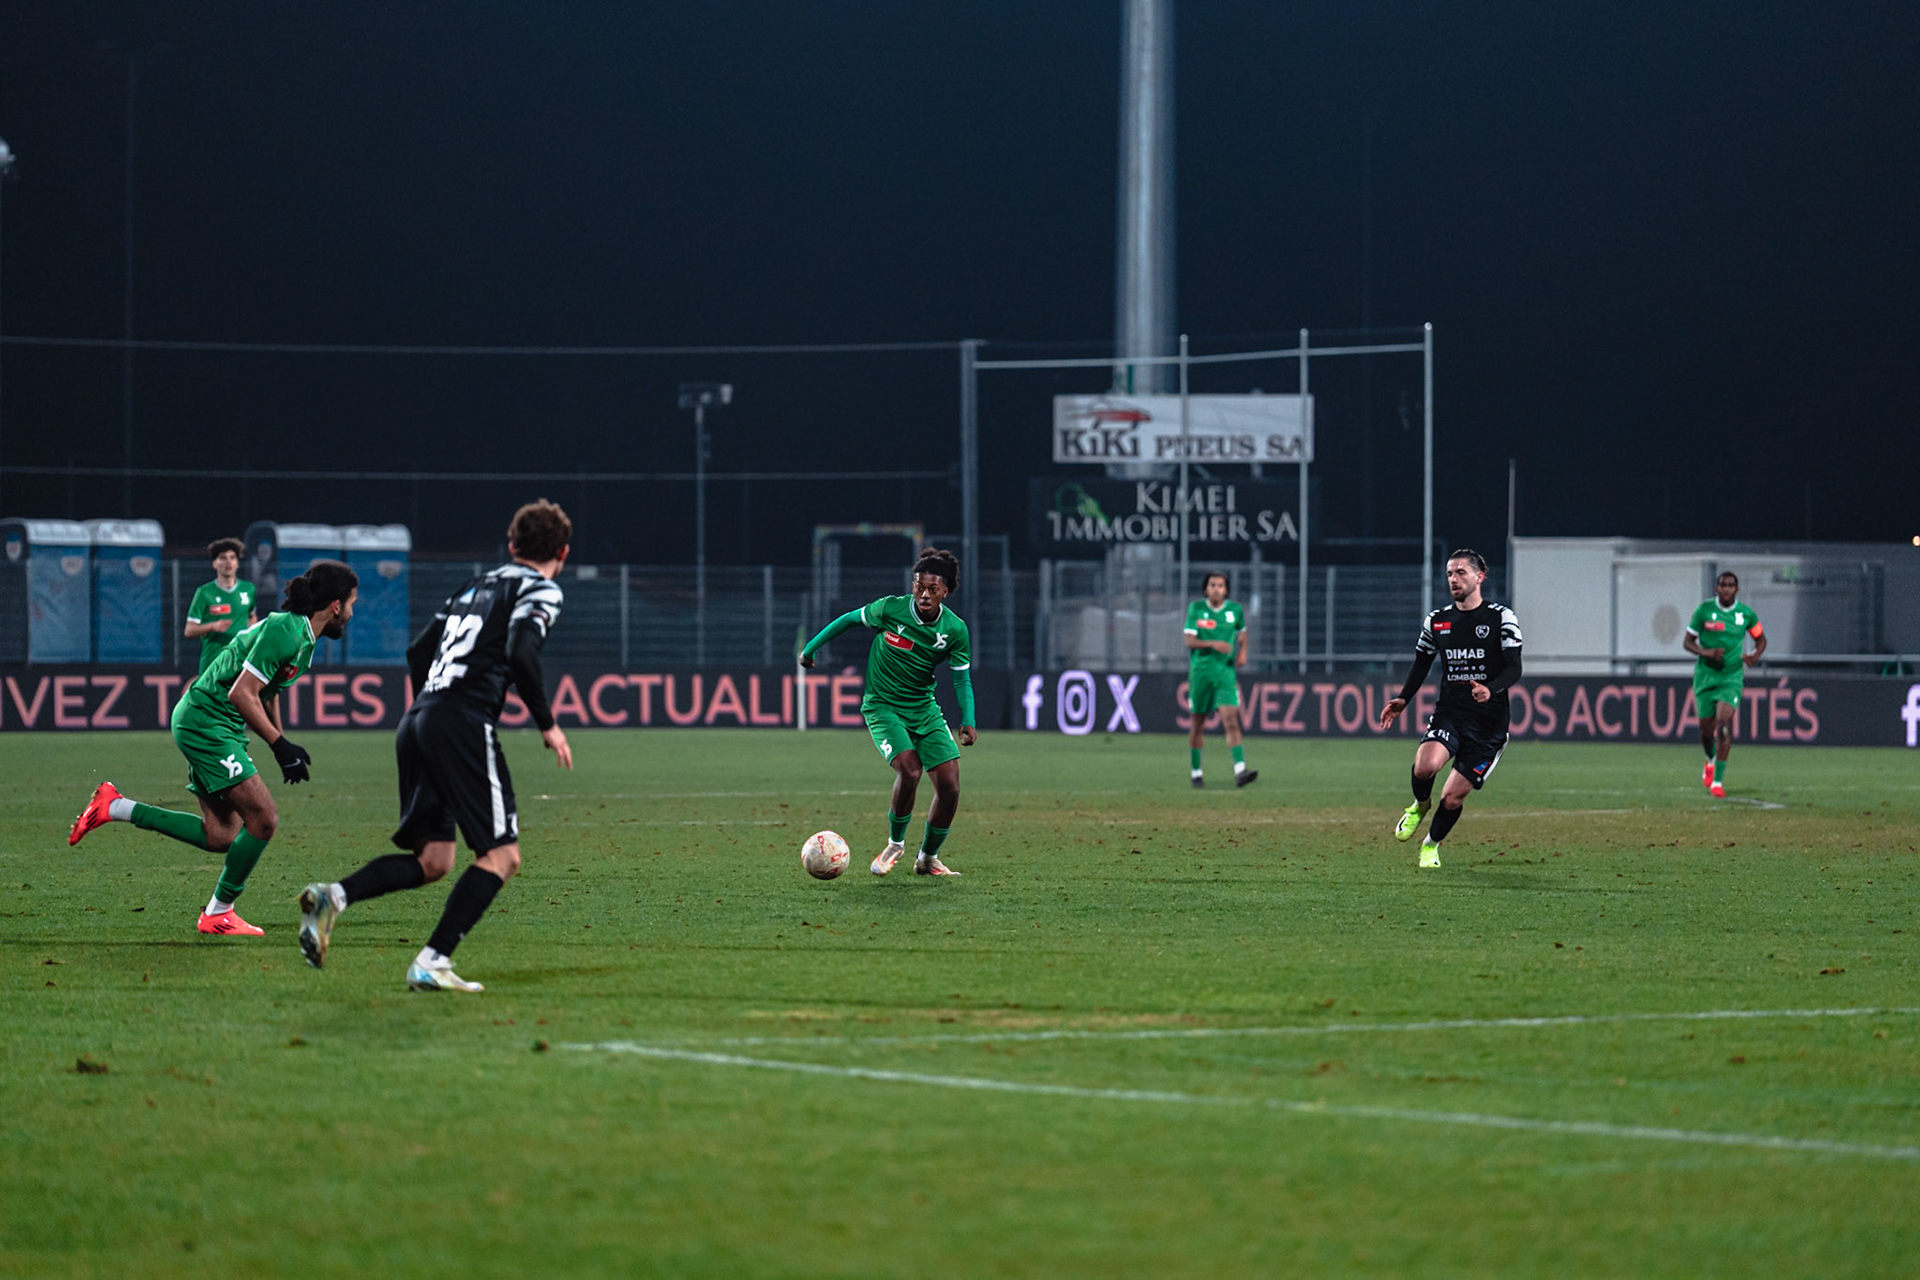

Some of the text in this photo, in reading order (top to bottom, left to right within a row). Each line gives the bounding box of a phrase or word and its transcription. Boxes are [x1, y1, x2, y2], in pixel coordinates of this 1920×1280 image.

[1154, 435, 1256, 458] PNEUS
[1265, 434, 1305, 458] SA
[1256, 509, 1299, 542] SA
[1445, 648, 1485, 659] DIMAB
[1447, 673, 1487, 681] LOMBARD
[549, 667, 864, 726] ACTUALITÉ
[1312, 682, 1437, 735] TOUTE
[1565, 677, 1819, 741] ACTUAITÉS
